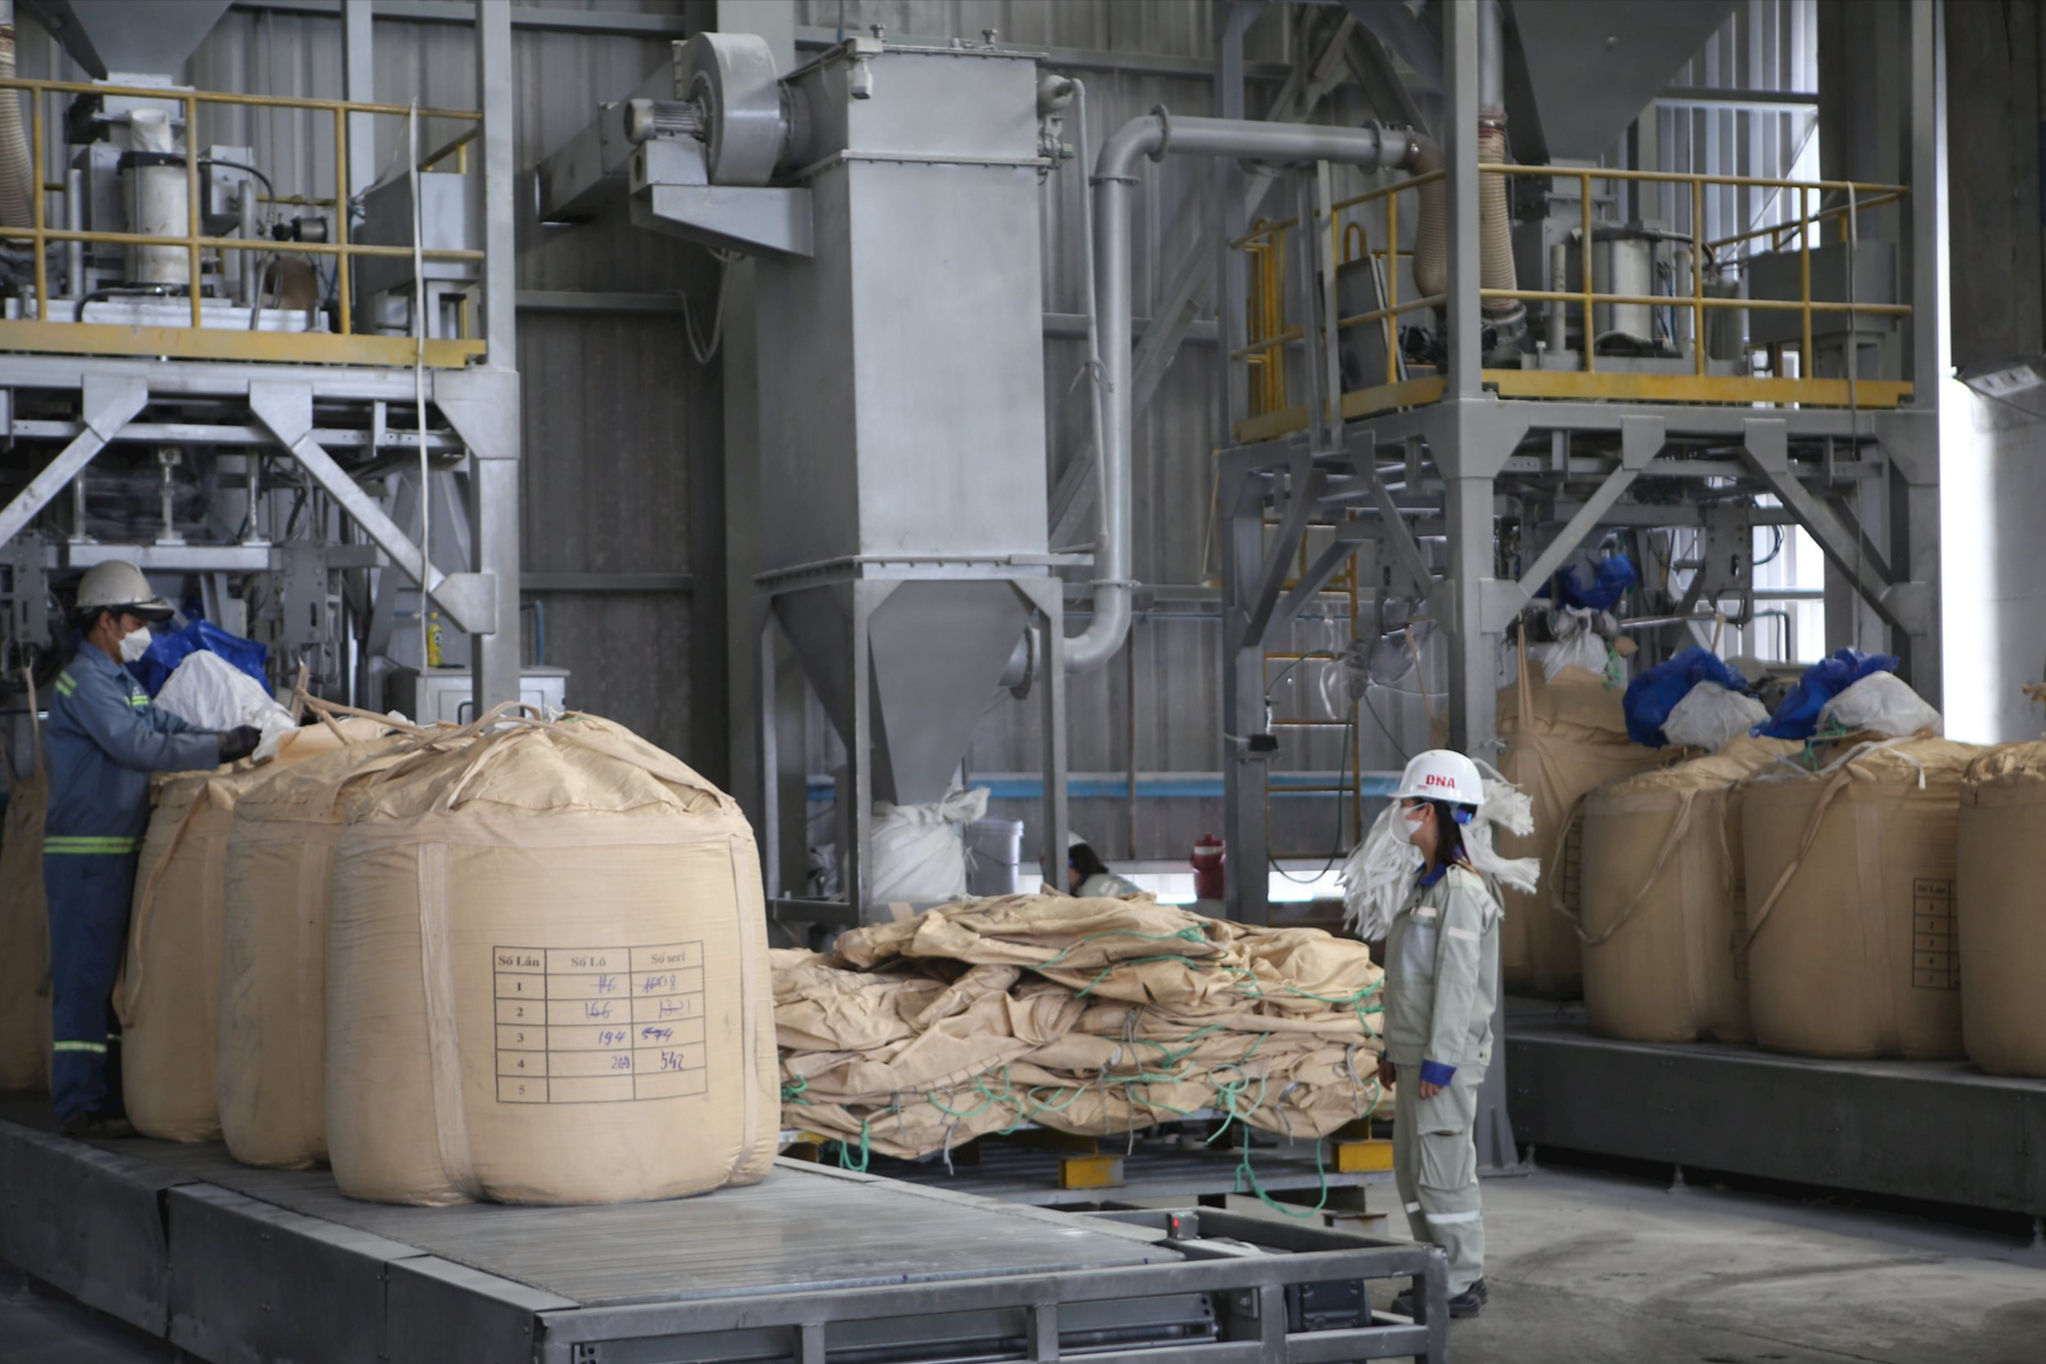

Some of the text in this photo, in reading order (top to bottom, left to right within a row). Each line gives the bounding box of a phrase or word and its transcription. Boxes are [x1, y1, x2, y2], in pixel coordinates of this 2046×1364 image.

[1426, 774, 1455, 789] DNA
[667, 951, 686, 962] seri
[516, 982, 522, 992] 1
[516, 1007, 524, 1017] 2
[517, 1033, 524, 1043] 3
[517, 1059, 525, 1069] 4
[518, 1085, 525, 1094] 5
